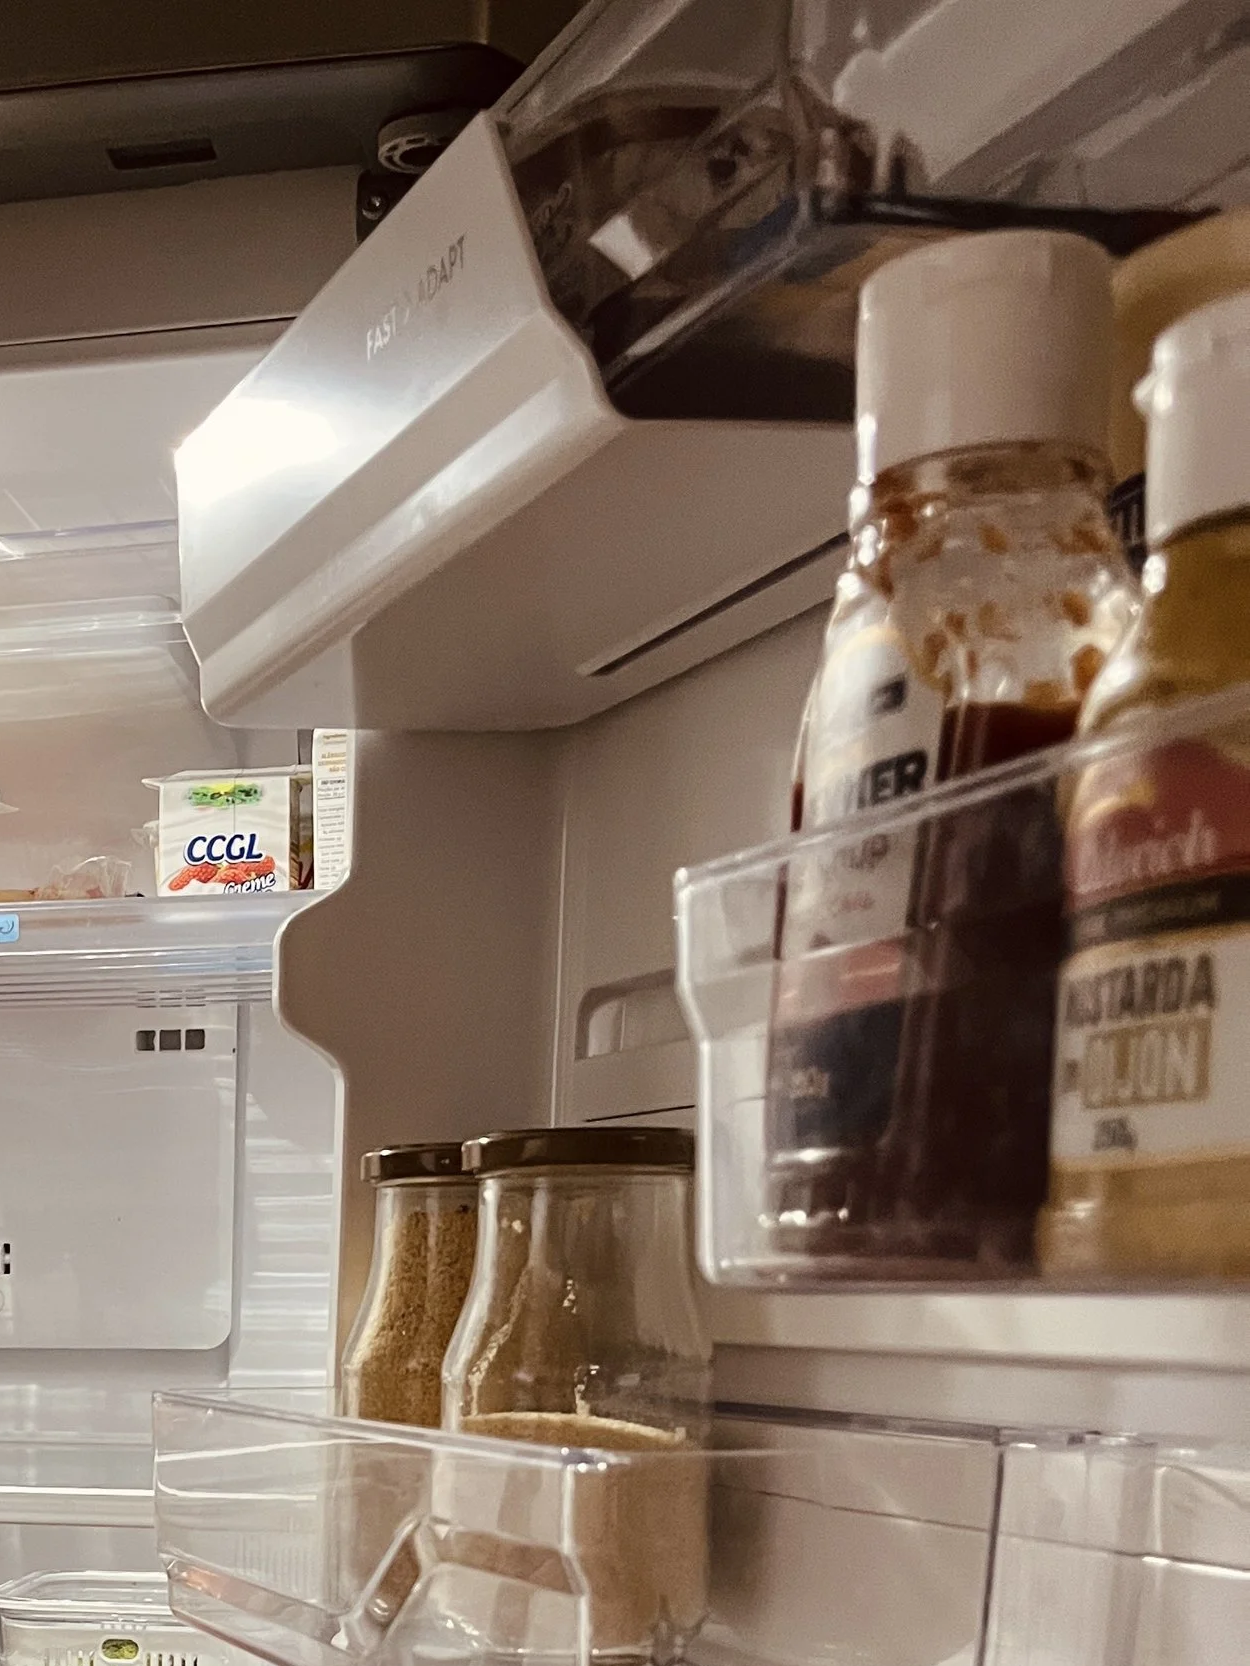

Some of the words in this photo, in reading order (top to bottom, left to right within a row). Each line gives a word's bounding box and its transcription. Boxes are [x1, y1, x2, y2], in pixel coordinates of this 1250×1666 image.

[366, 305, 397, 361] FAST
[186, 833, 263, 862] CCGL
[224, 872, 276, 894] Creme
